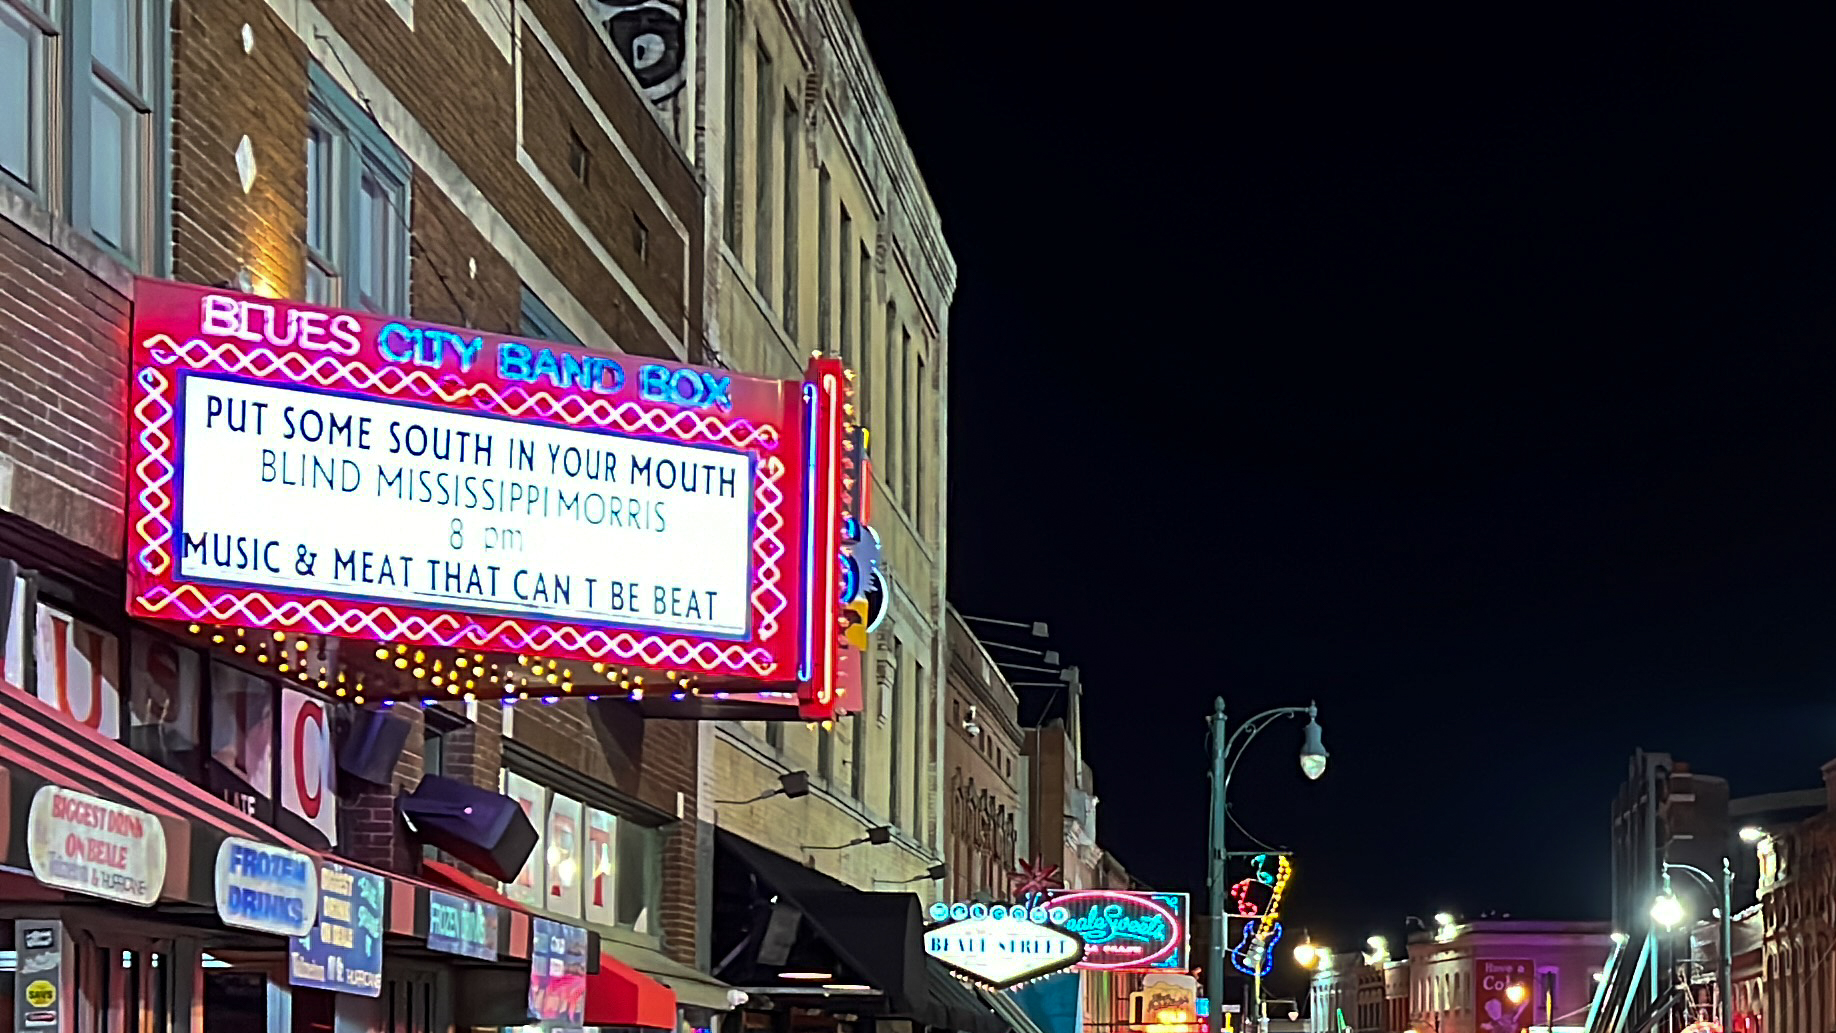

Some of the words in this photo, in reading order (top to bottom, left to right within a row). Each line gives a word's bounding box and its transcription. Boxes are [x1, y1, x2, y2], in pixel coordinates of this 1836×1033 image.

[202, 295, 361, 356] BLUES
[377, 321, 483, 373] CITY
[497, 342, 625, 394] BAND
[639, 363, 734, 413] BOX
[206, 395, 268, 434] PUT
[283, 405, 372, 450] SOME
[389, 421, 493, 467] SOUTH
[509, 438, 535, 472] IN
[549, 442, 616, 484] YOUR
[630, 456, 737, 498] MOUTH
[262, 448, 361, 493] BLIND
[377, 465, 549, 518] MISSISSIPPI
[559, 493, 666, 533] MORRIS
[449, 517, 463, 550] 8
[485, 524, 523, 553] pm
[182, 531, 281, 574] MUSIC
[295, 543, 317, 576] &
[334, 547, 413, 588] MEAT
[427, 559, 500, 598] THAT
[514, 567, 571, 607] CAN
[584, 578, 597, 608] T
[611, 580, 640, 613] BE
[653, 586, 718, 621] BEAT
[66, 833, 85, 862] ON
[87, 838, 128, 870] BEALE
[229, 844, 307, 886] FROZEN
[228, 885, 305, 929] DRINKS
[931, 937, 985, 952] BEALE
[998, 939, 1065, 954] STREET
